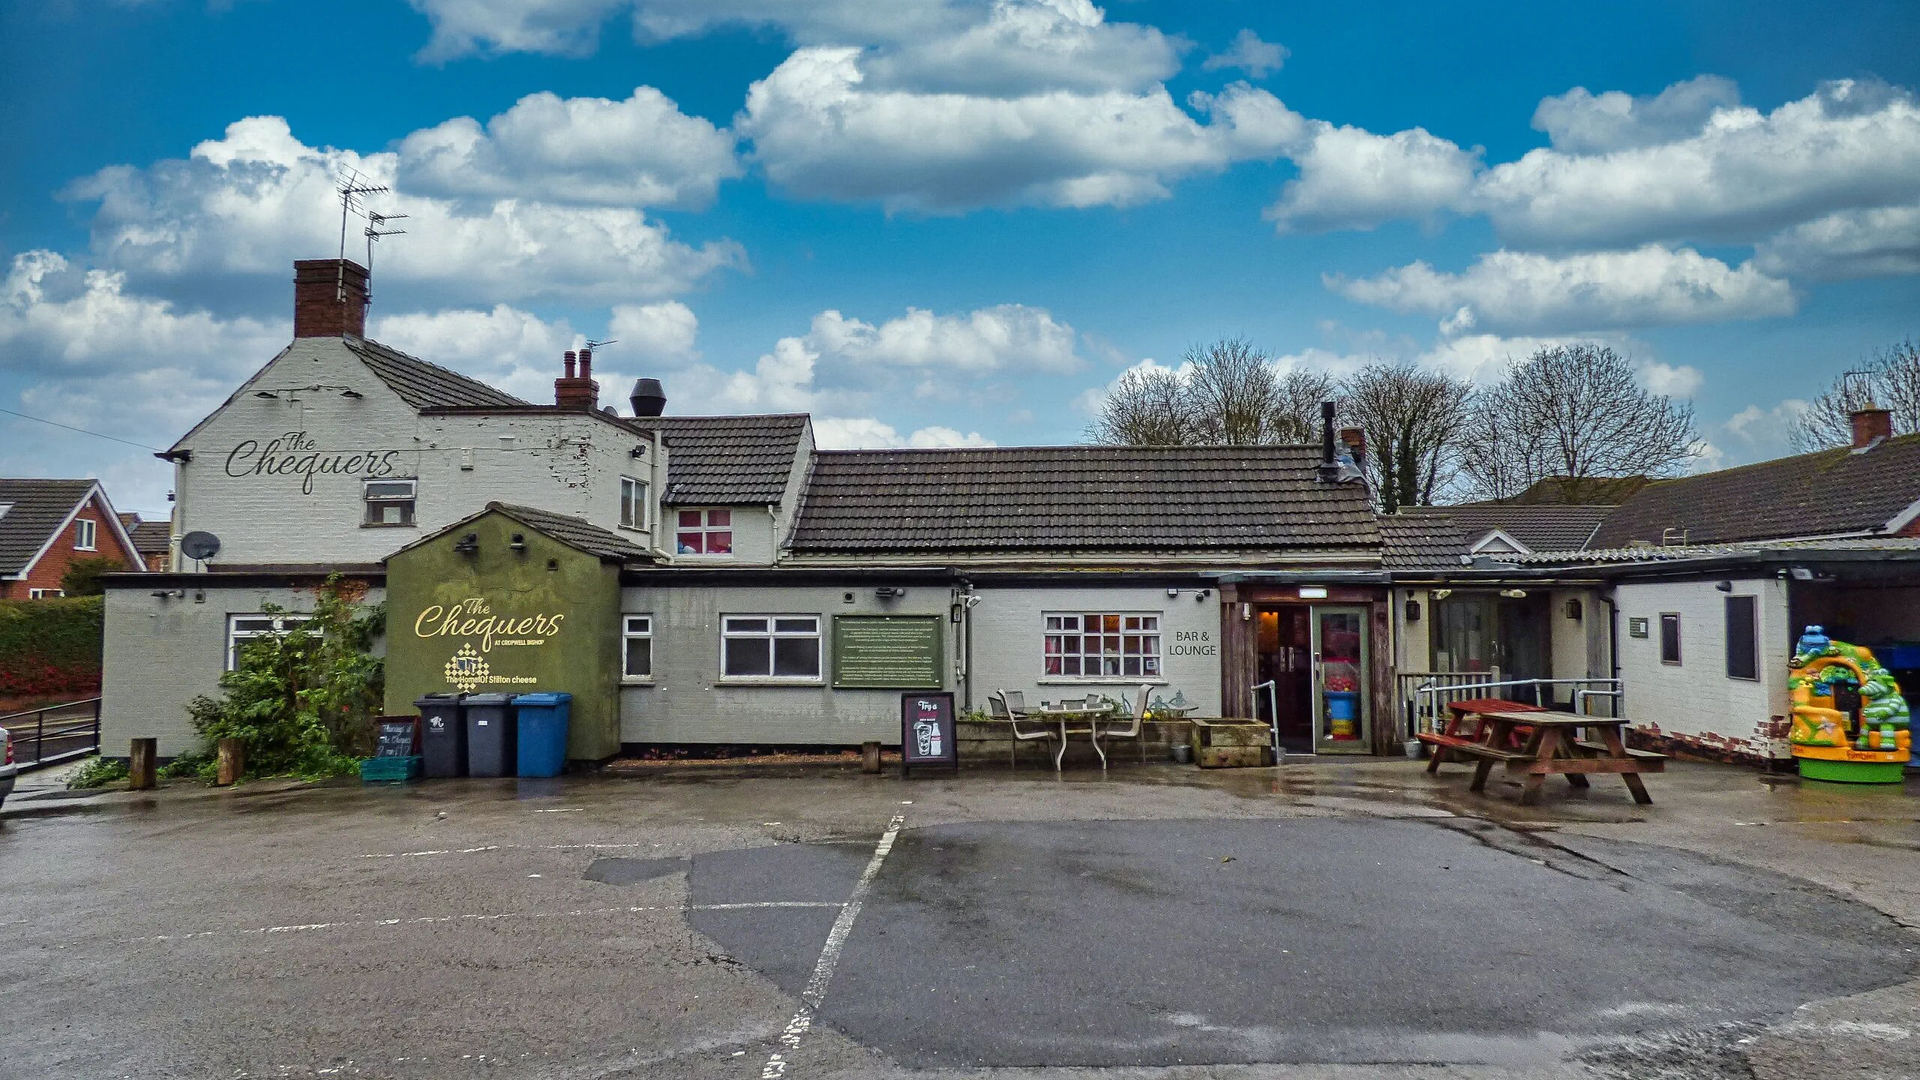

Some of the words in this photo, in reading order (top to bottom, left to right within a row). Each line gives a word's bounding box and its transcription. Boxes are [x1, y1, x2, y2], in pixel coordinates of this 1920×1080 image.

[283, 431, 316, 451] The
[225, 439, 399, 495] Chequers
[463, 597, 490, 615] The
[414, 604, 564, 653] Chequers
[1176, 631, 1198, 641] BAR
[1201, 631, 1210, 642] &
[1169, 645, 1217, 656] LOUNGE
[489, 675, 511, 684] Stilton
[511, 675, 537, 684] cheese
[918, 701, 931, 711] Try
